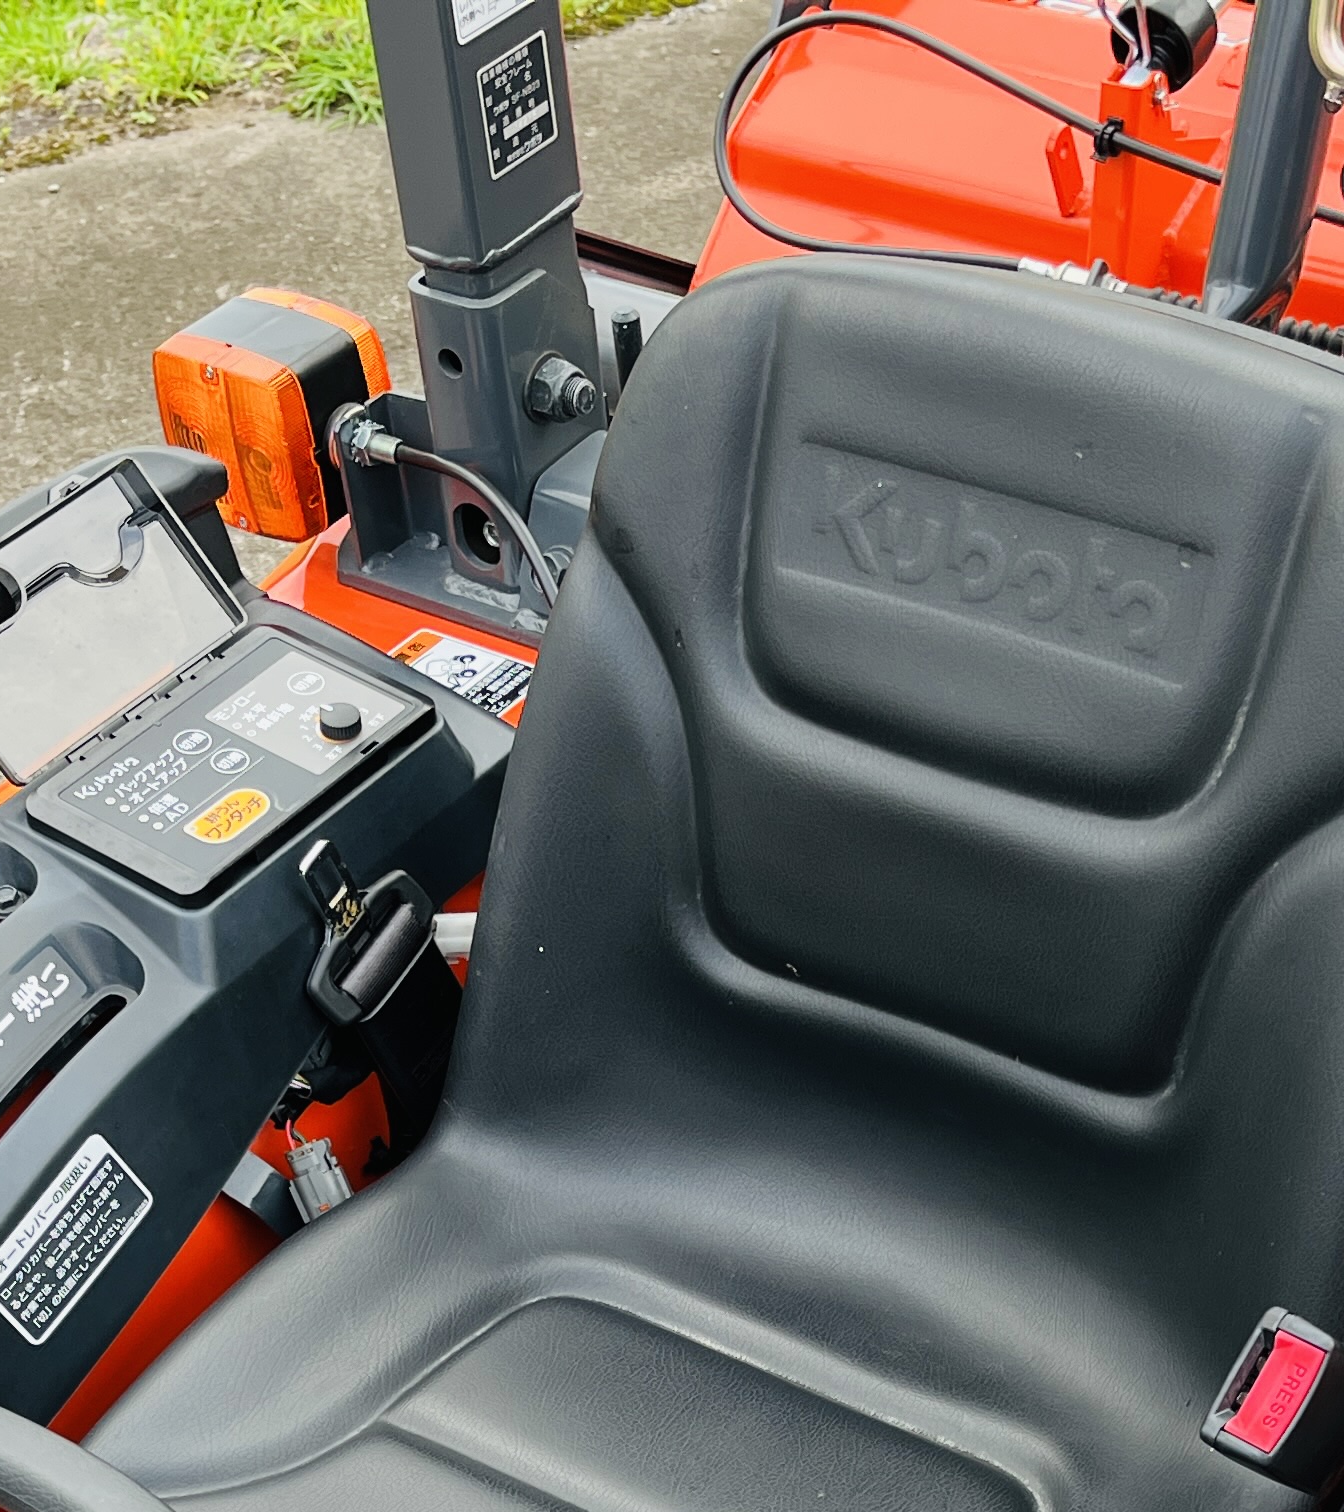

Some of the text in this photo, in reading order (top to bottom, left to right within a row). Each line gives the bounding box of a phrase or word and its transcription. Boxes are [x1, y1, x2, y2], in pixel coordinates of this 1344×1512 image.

[813, 458, 1176, 660] Kubota
[73, 753, 140, 802] Kubota
[112, 748, 178, 797] バックアップ
[127, 757, 192, 805] オートアップ
[163, 802, 191, 821] AD
[203, 795, 266, 841] ワンタッチ
[12, 962, 69, 1022] 浅い
[1262, 1362, 1307, 1428] PRESS
